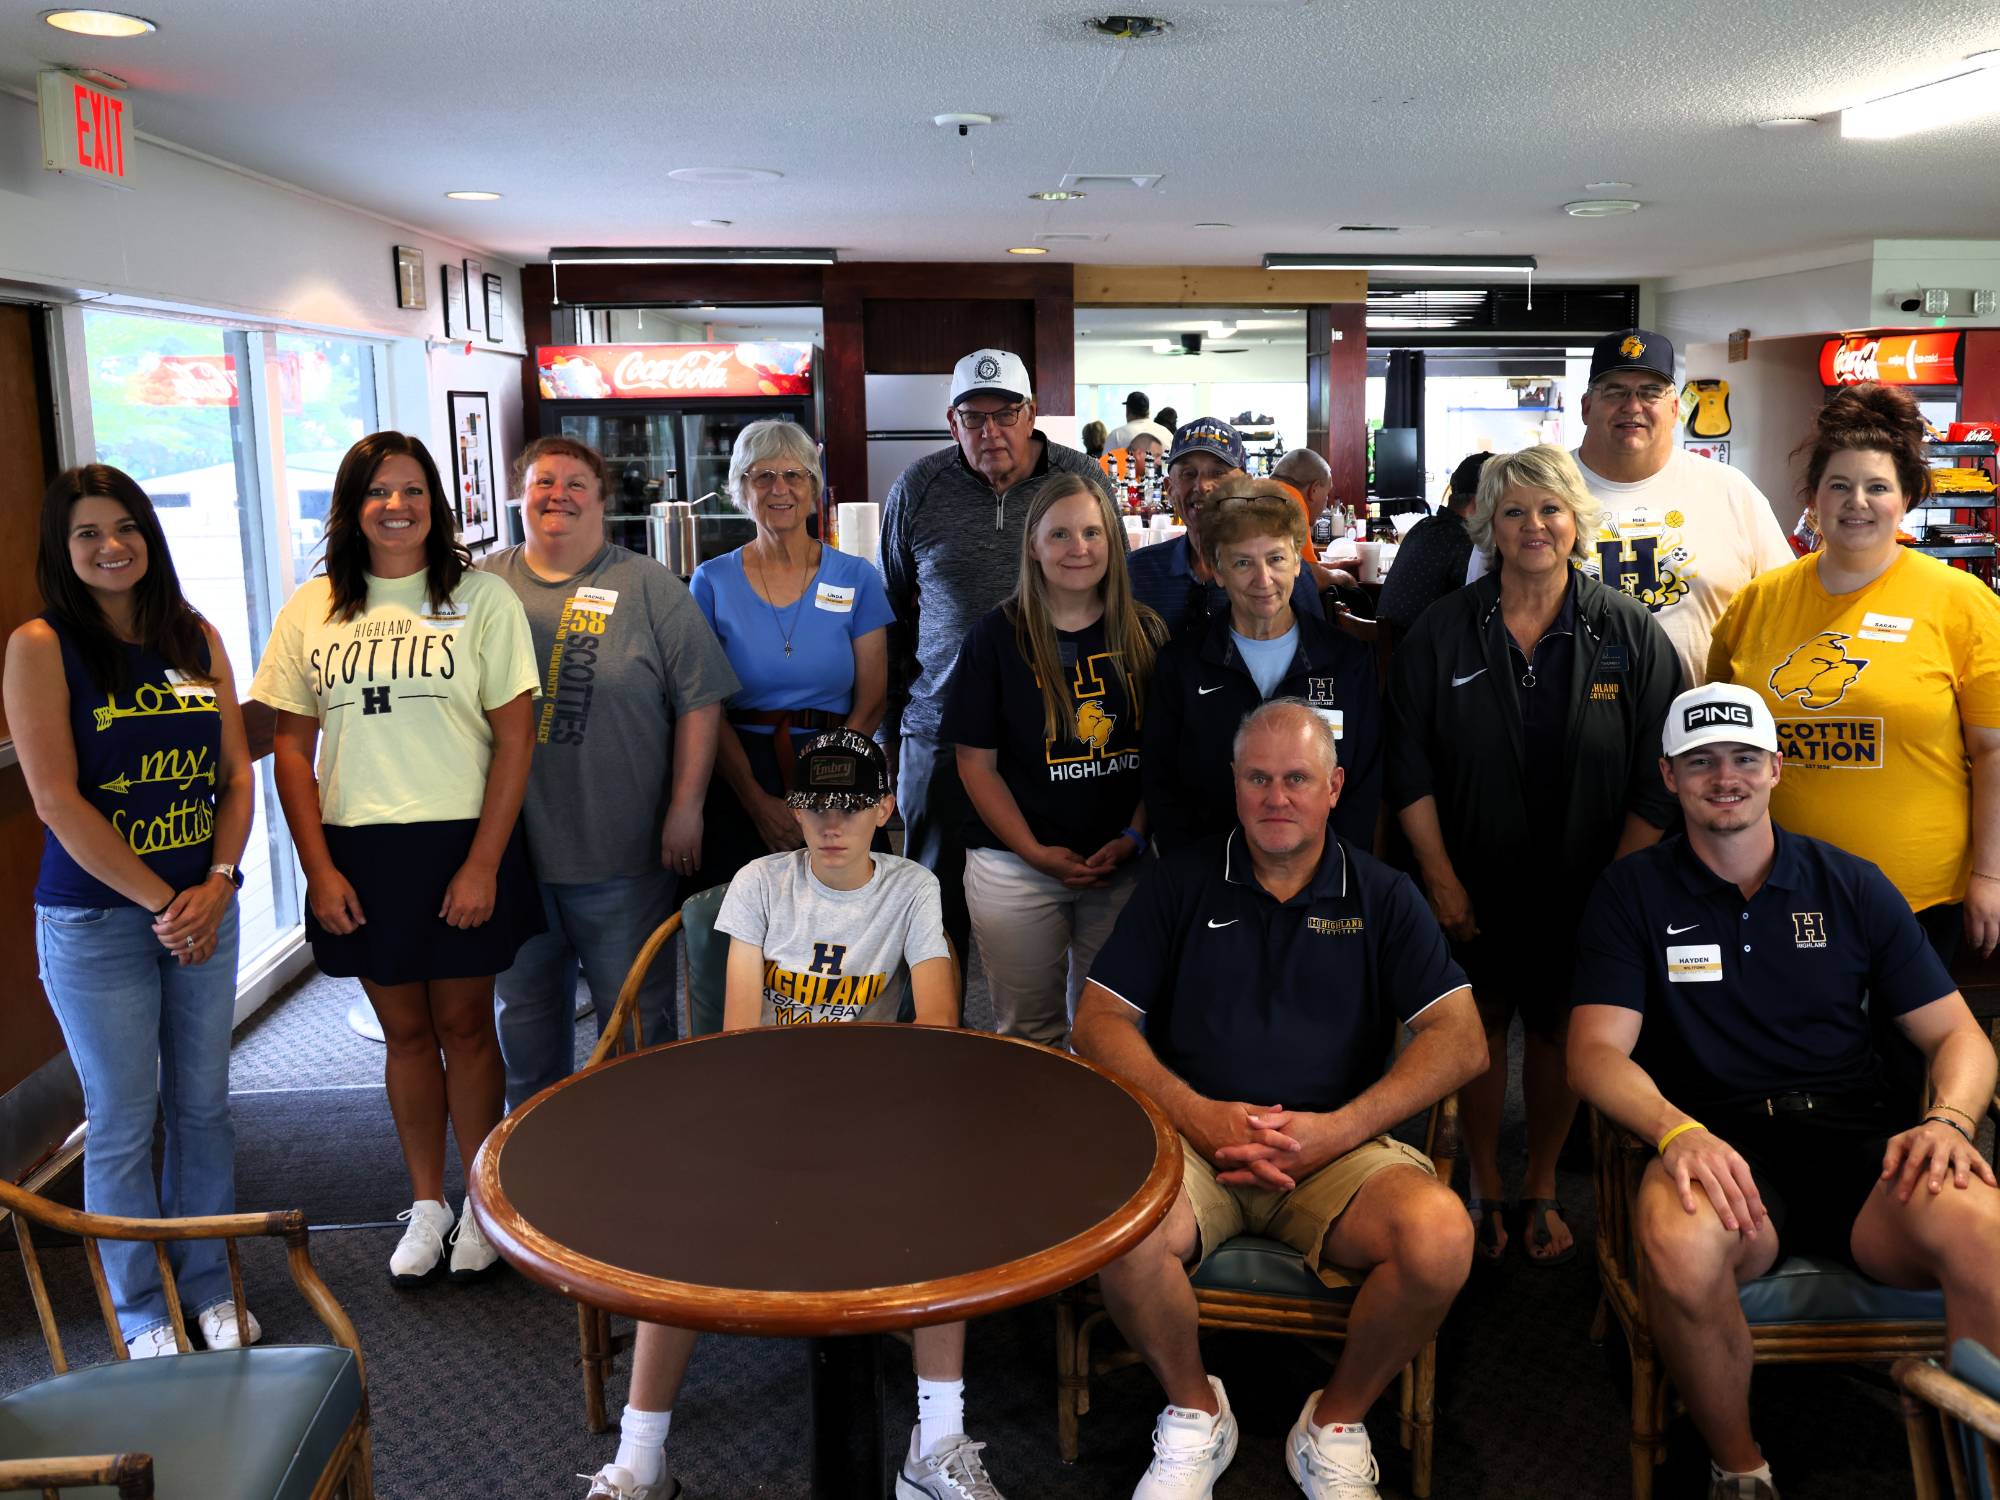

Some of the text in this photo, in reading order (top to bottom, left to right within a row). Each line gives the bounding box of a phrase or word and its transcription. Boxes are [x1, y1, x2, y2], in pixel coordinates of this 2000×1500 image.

[74, 84, 124, 176] EXIT
[614, 351, 733, 390] Coca-Cola
[354, 619, 412, 638] HIGHLAND
[311, 634, 455, 696] SCOTTIES
[362, 686, 392, 715] H
[551, 634, 600, 746] SCOTTIES
[1308, 677, 1335, 702] H
[1688, 706, 1749, 727] PING
[1776, 723, 1876, 741] COTTIE
[140, 746, 208, 790] my
[1050, 754, 1141, 782] HIGHLAND
[1321, 919, 1364, 930] HIGHLAND
[1792, 912, 1828, 943] H
[809, 943, 847, 976] H
[764, 960, 886, 1007] IGHLAND
